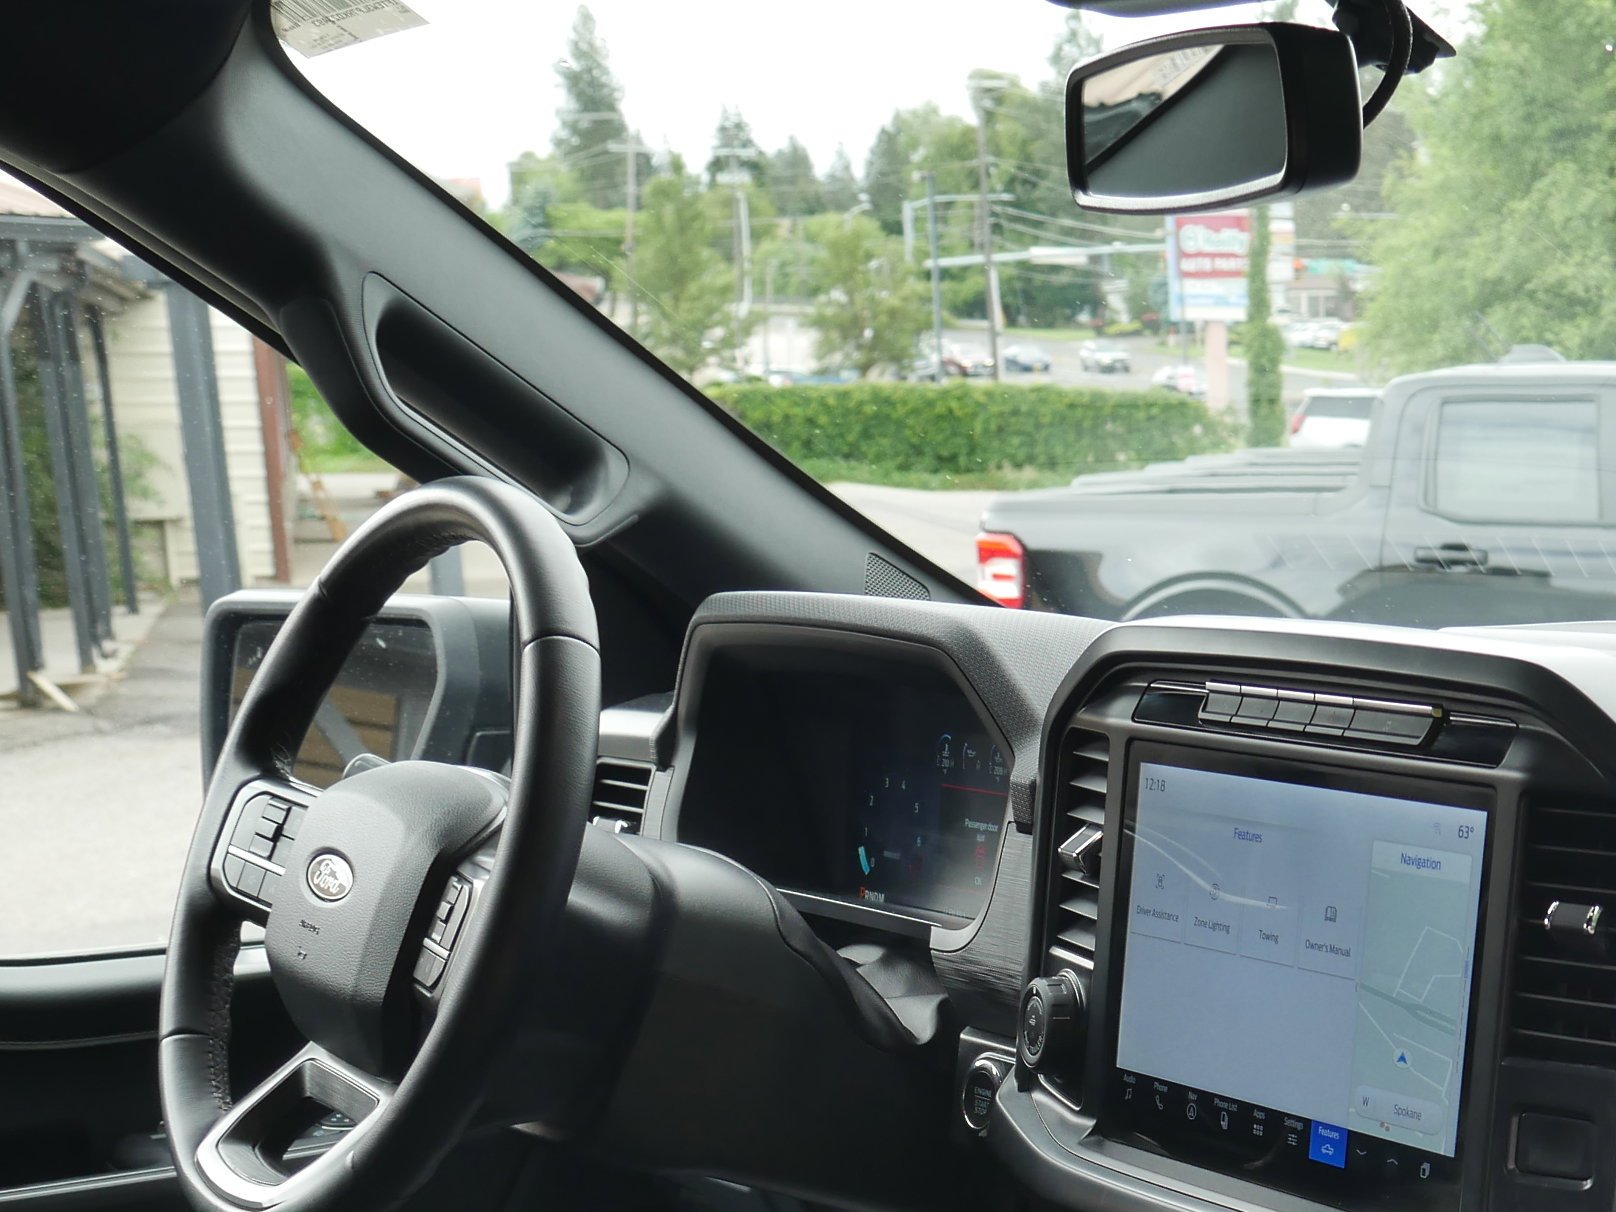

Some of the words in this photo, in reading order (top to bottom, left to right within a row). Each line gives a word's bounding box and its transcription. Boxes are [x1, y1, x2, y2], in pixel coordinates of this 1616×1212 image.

[1145, 777, 1167, 793] 12:18
[1233, 827, 1263, 844] Features
[1400, 852, 1442, 870] Navigation
[313, 859, 340, 894] Ford
[1136, 905, 1152, 917] Driver
[1152, 908, 1180, 922] Assistance
[1193, 916, 1208, 929] Zone
[1208, 919, 1231, 934] Lighting
[1259, 929, 1279, 944] Towing
[1305, 939, 1328, 953] Owner's
[1328, 943, 1351, 957] Manual
[1123, 1073, 1136, 1084] Audio
[1153, 1081, 1168, 1093] Phone
[1213, 1097, 1228, 1109] Phone
[1228, 1101, 1238, 1112] List
[1362, 1096, 1370, 1107] W
[1393, 1104, 1422, 1120] Spokane
[1253, 1108, 1266, 1120] Apps
[1284, 1116, 1304, 1130] Settings
[1318, 1126, 1340, 1140] Features
